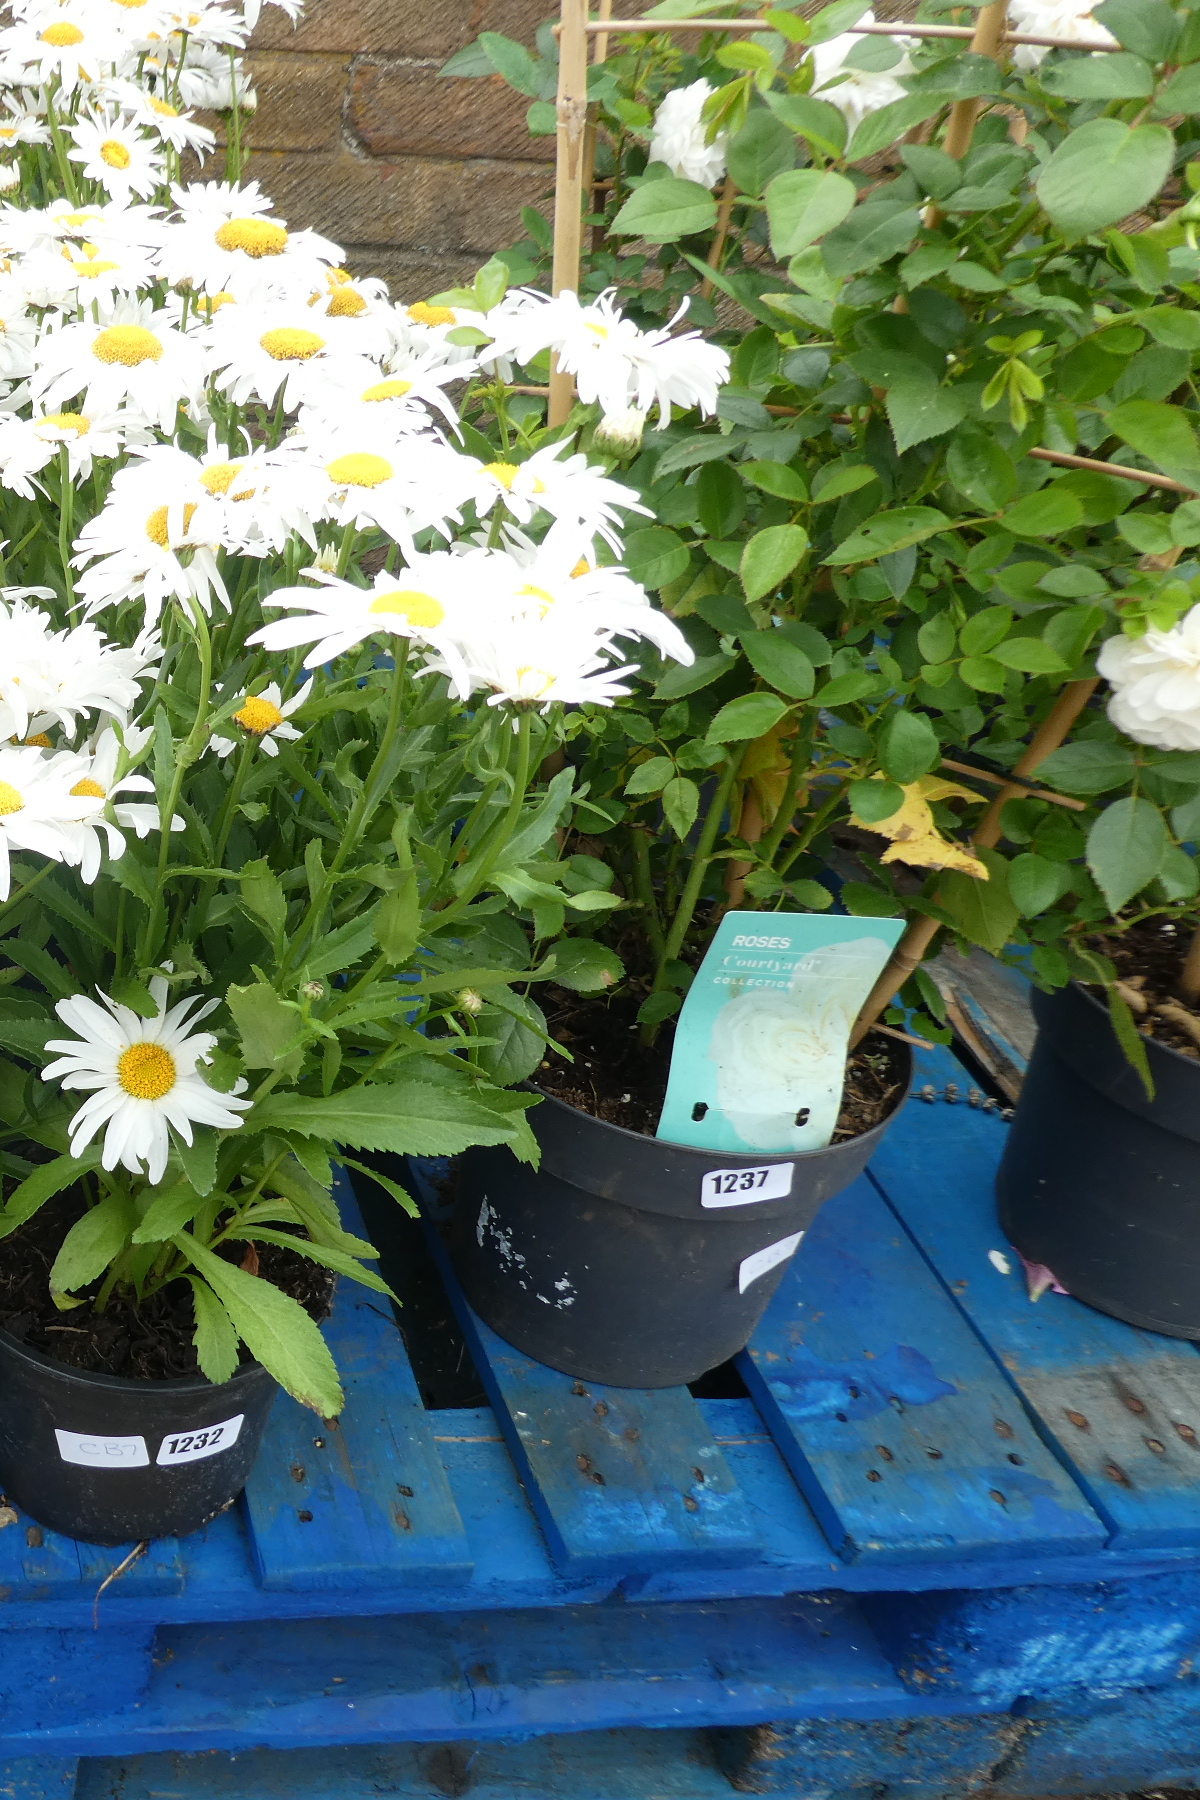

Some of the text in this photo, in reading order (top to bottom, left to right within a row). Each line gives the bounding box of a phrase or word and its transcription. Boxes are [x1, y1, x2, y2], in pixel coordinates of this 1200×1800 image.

[732, 935, 792, 949] ROSES
[713, 977, 795, 988] COLLECTION
[711, 1170, 769, 1194] 1237
[168, 1427, 224, 1454] 1232
